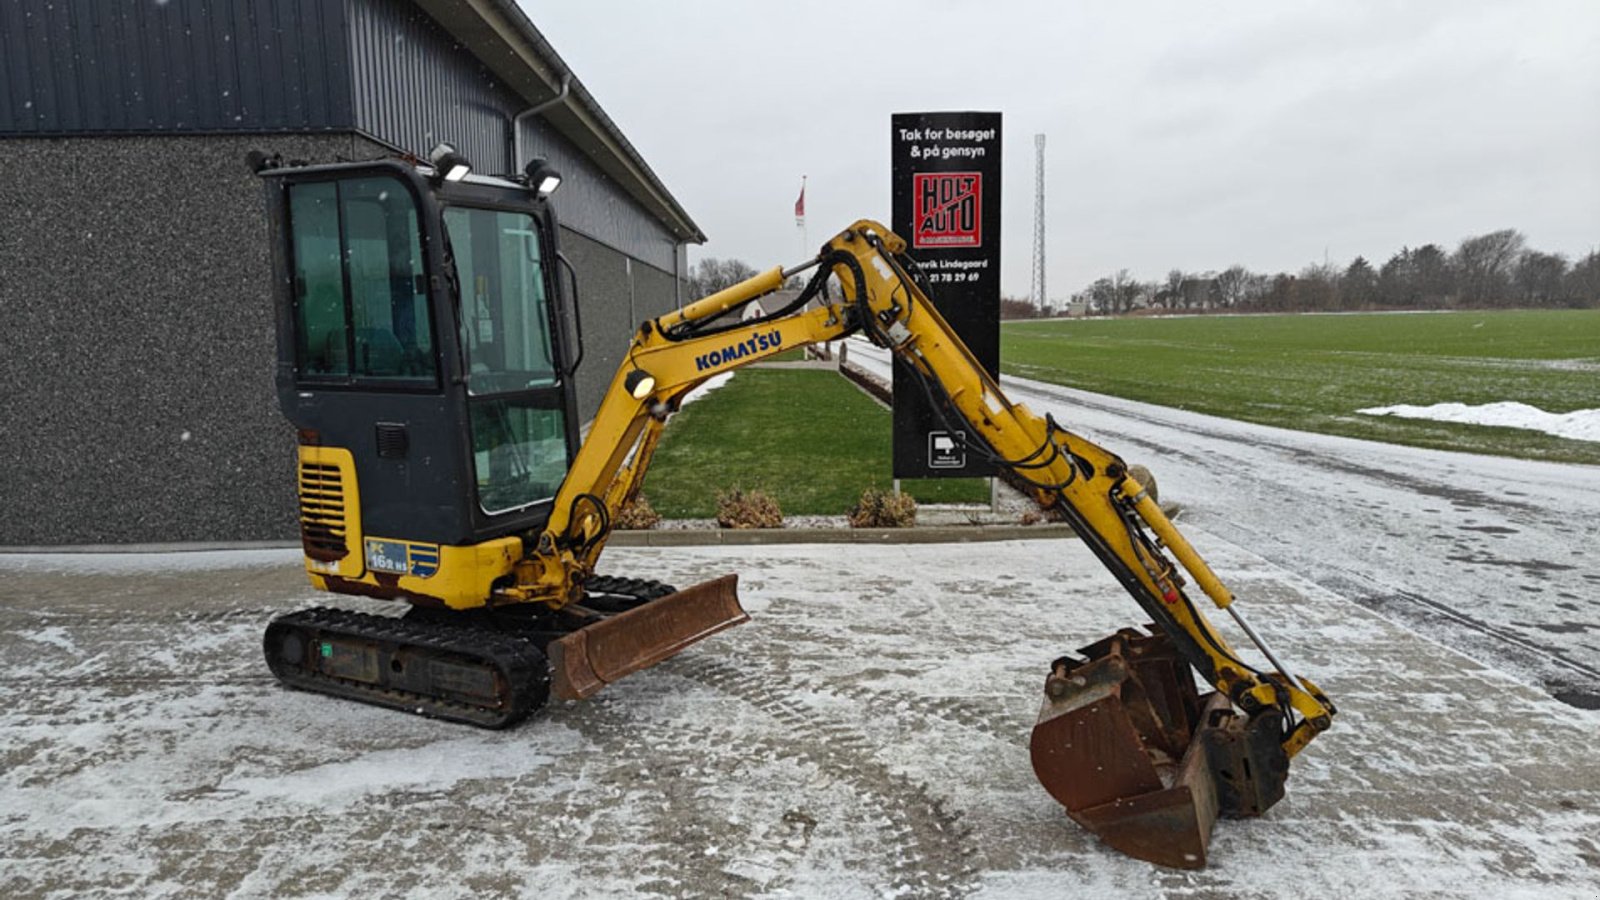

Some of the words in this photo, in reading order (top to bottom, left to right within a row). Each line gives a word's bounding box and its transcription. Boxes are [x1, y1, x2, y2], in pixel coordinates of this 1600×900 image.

[900, 128, 921, 140] Tak
[924, 127, 943, 140] for
[945, 127, 995, 142] besøget
[910, 145, 921, 157] &
[923, 144, 940, 160] på
[942, 147, 985, 159] gensyn
[922, 176, 976, 216] HOLT
[919, 193, 976, 233] AUTO
[940, 260, 988, 271] Lindegaard
[929, 273, 940, 282] 21
[941, 273, 953, 282] 78
[954, 273, 966, 282] 29
[967, 271, 980, 282] 69
[695, 330, 782, 372] KOMATSU
